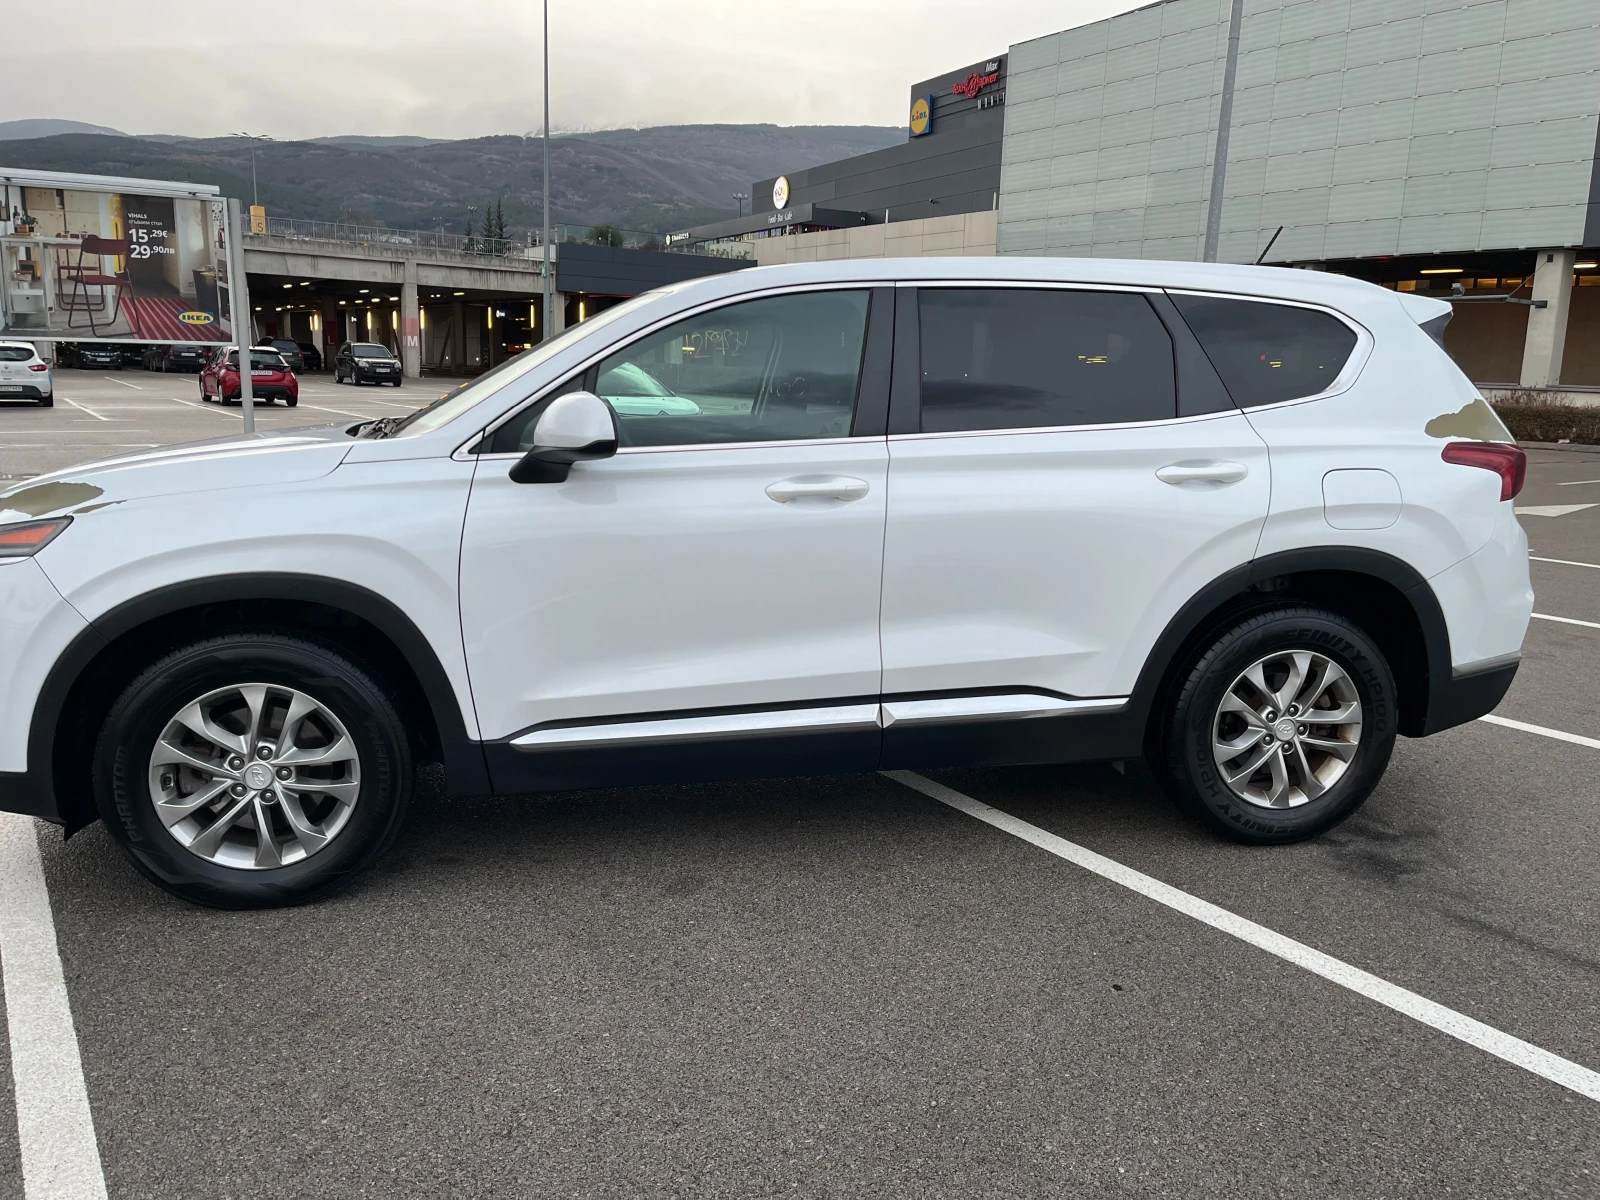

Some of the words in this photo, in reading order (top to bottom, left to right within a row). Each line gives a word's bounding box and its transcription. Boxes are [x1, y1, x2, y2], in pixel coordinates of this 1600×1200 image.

[985, 62, 998, 72] Max
[257, 222, 263, 232] S
[407, 335, 418, 347] M
[111, 744, 145, 844] PHANTOM
